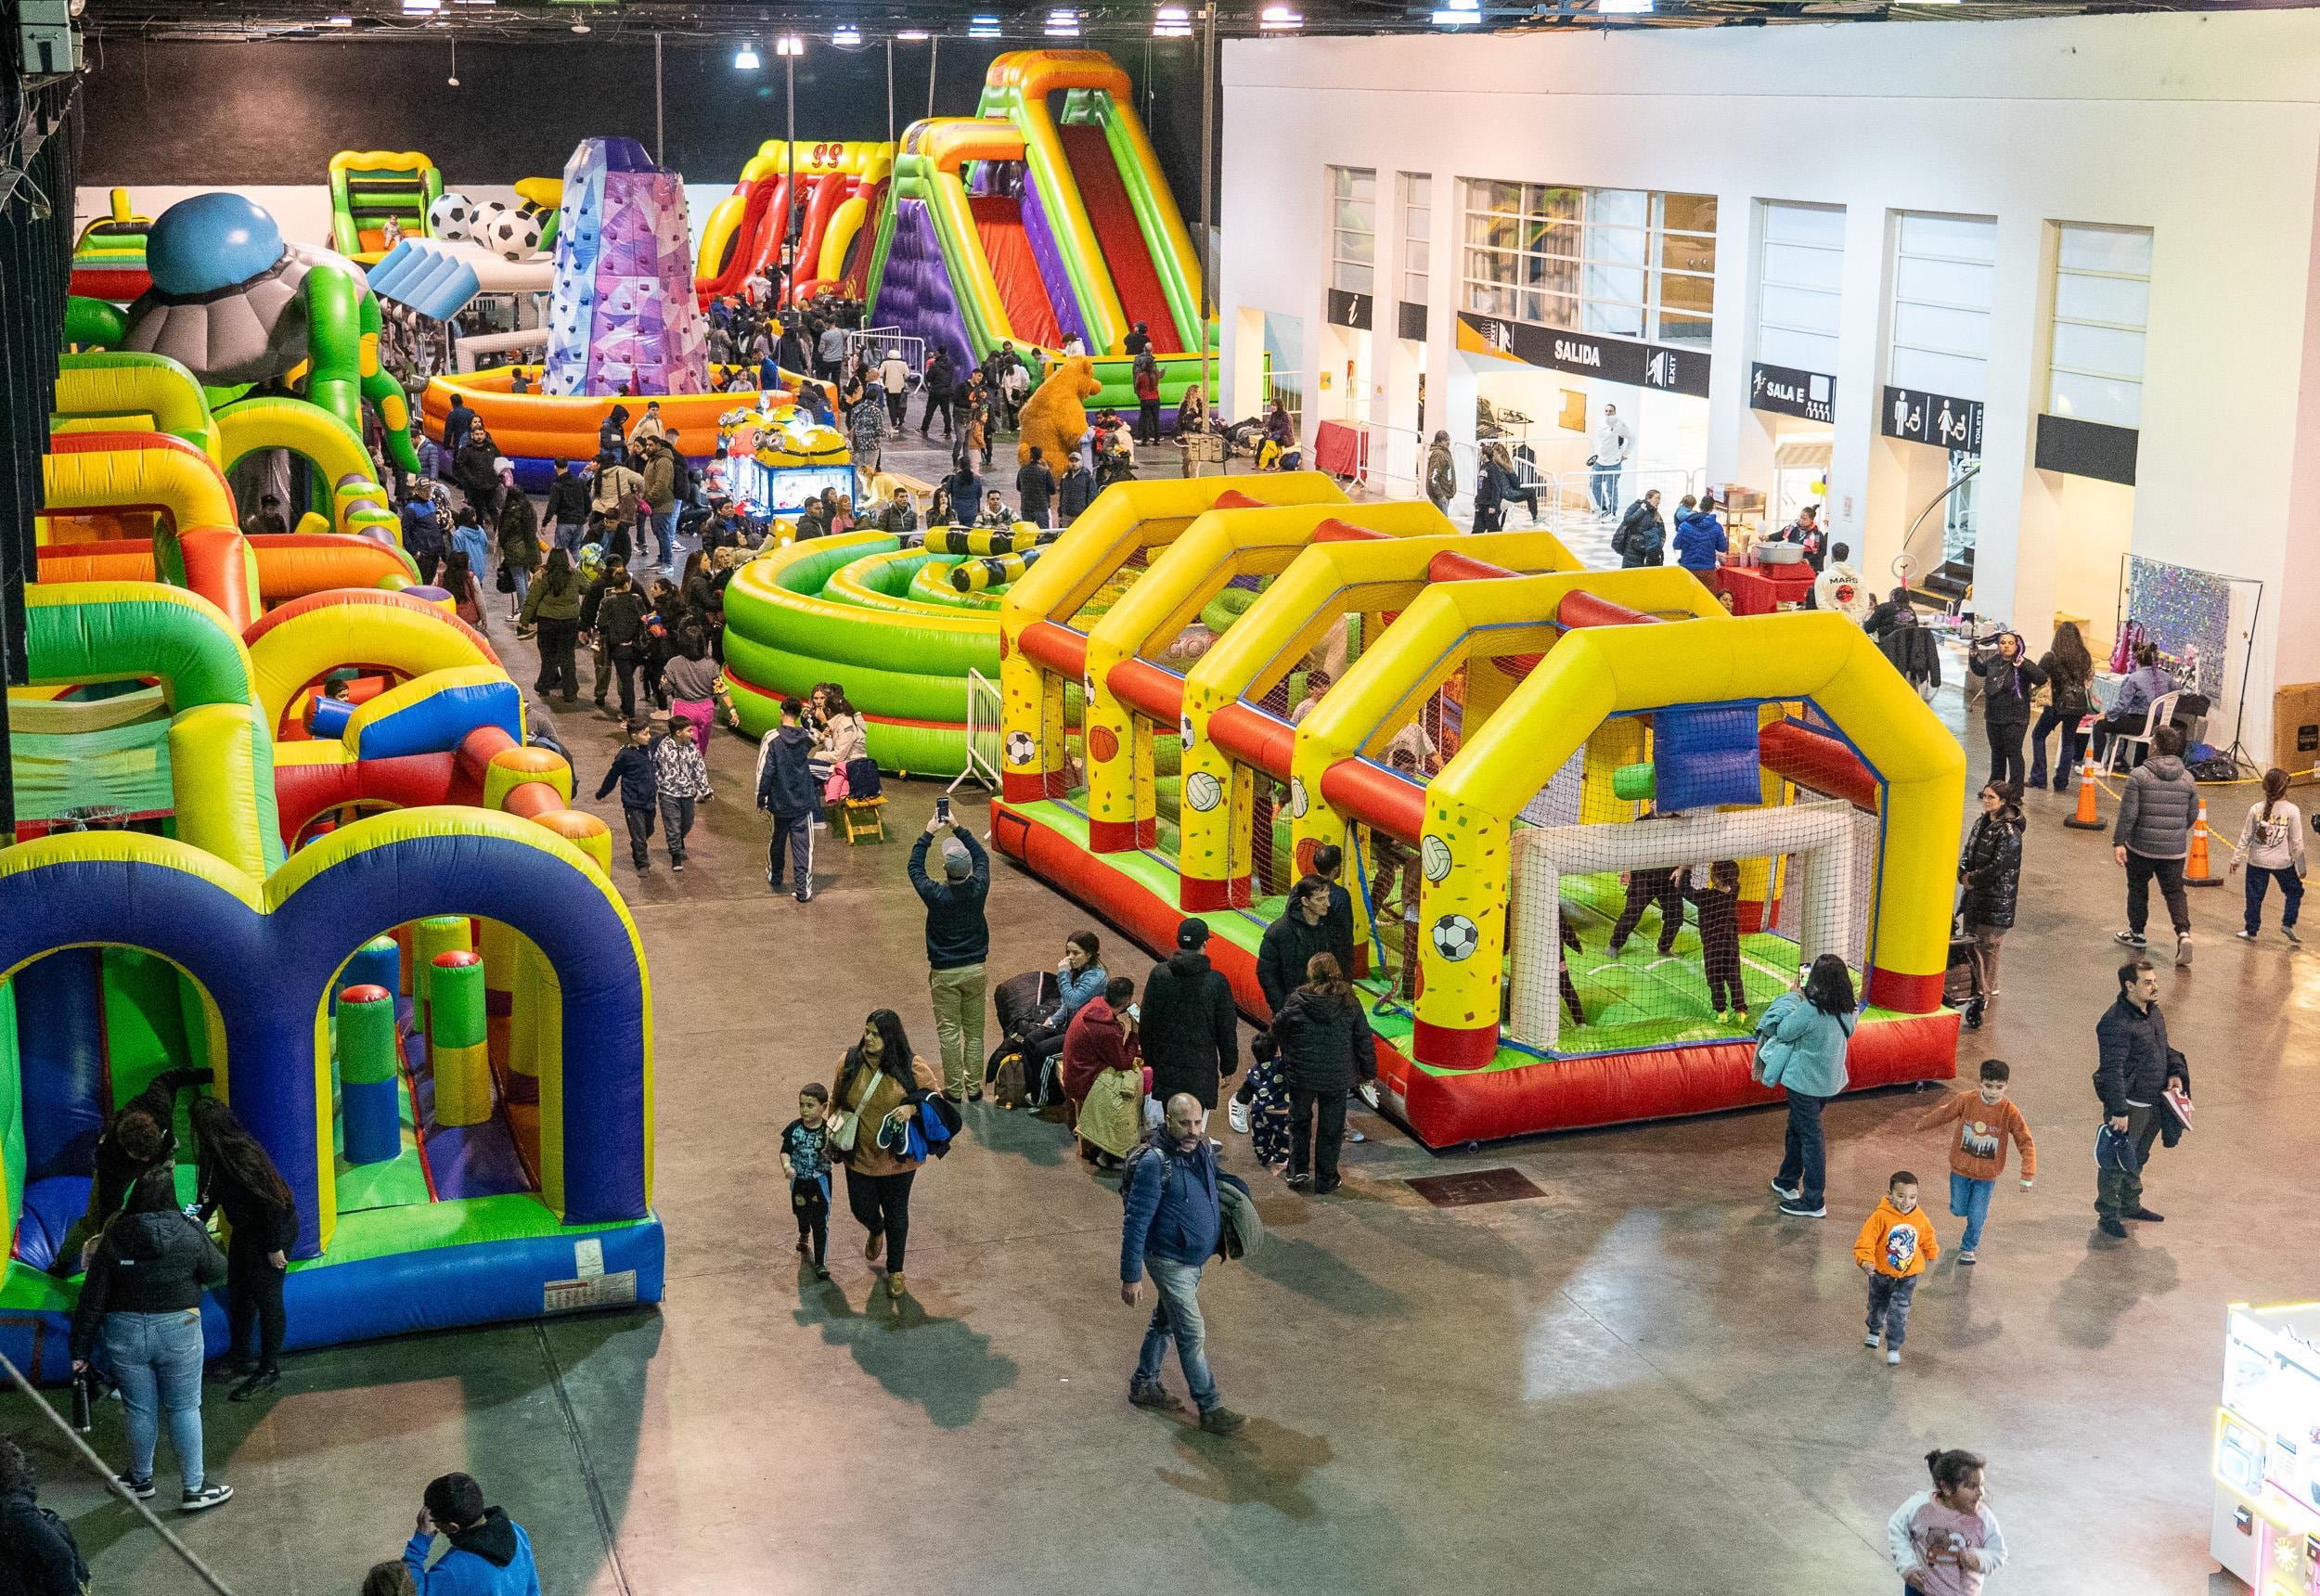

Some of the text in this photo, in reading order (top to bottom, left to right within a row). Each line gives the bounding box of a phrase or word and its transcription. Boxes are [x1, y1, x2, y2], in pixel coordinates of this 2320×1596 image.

[812, 144, 843, 168] 99
[1554, 340, 1601, 367] SALIDA
[1668, 354, 1677, 384] EXIT
[1766, 381, 1805, 404] SALA E
